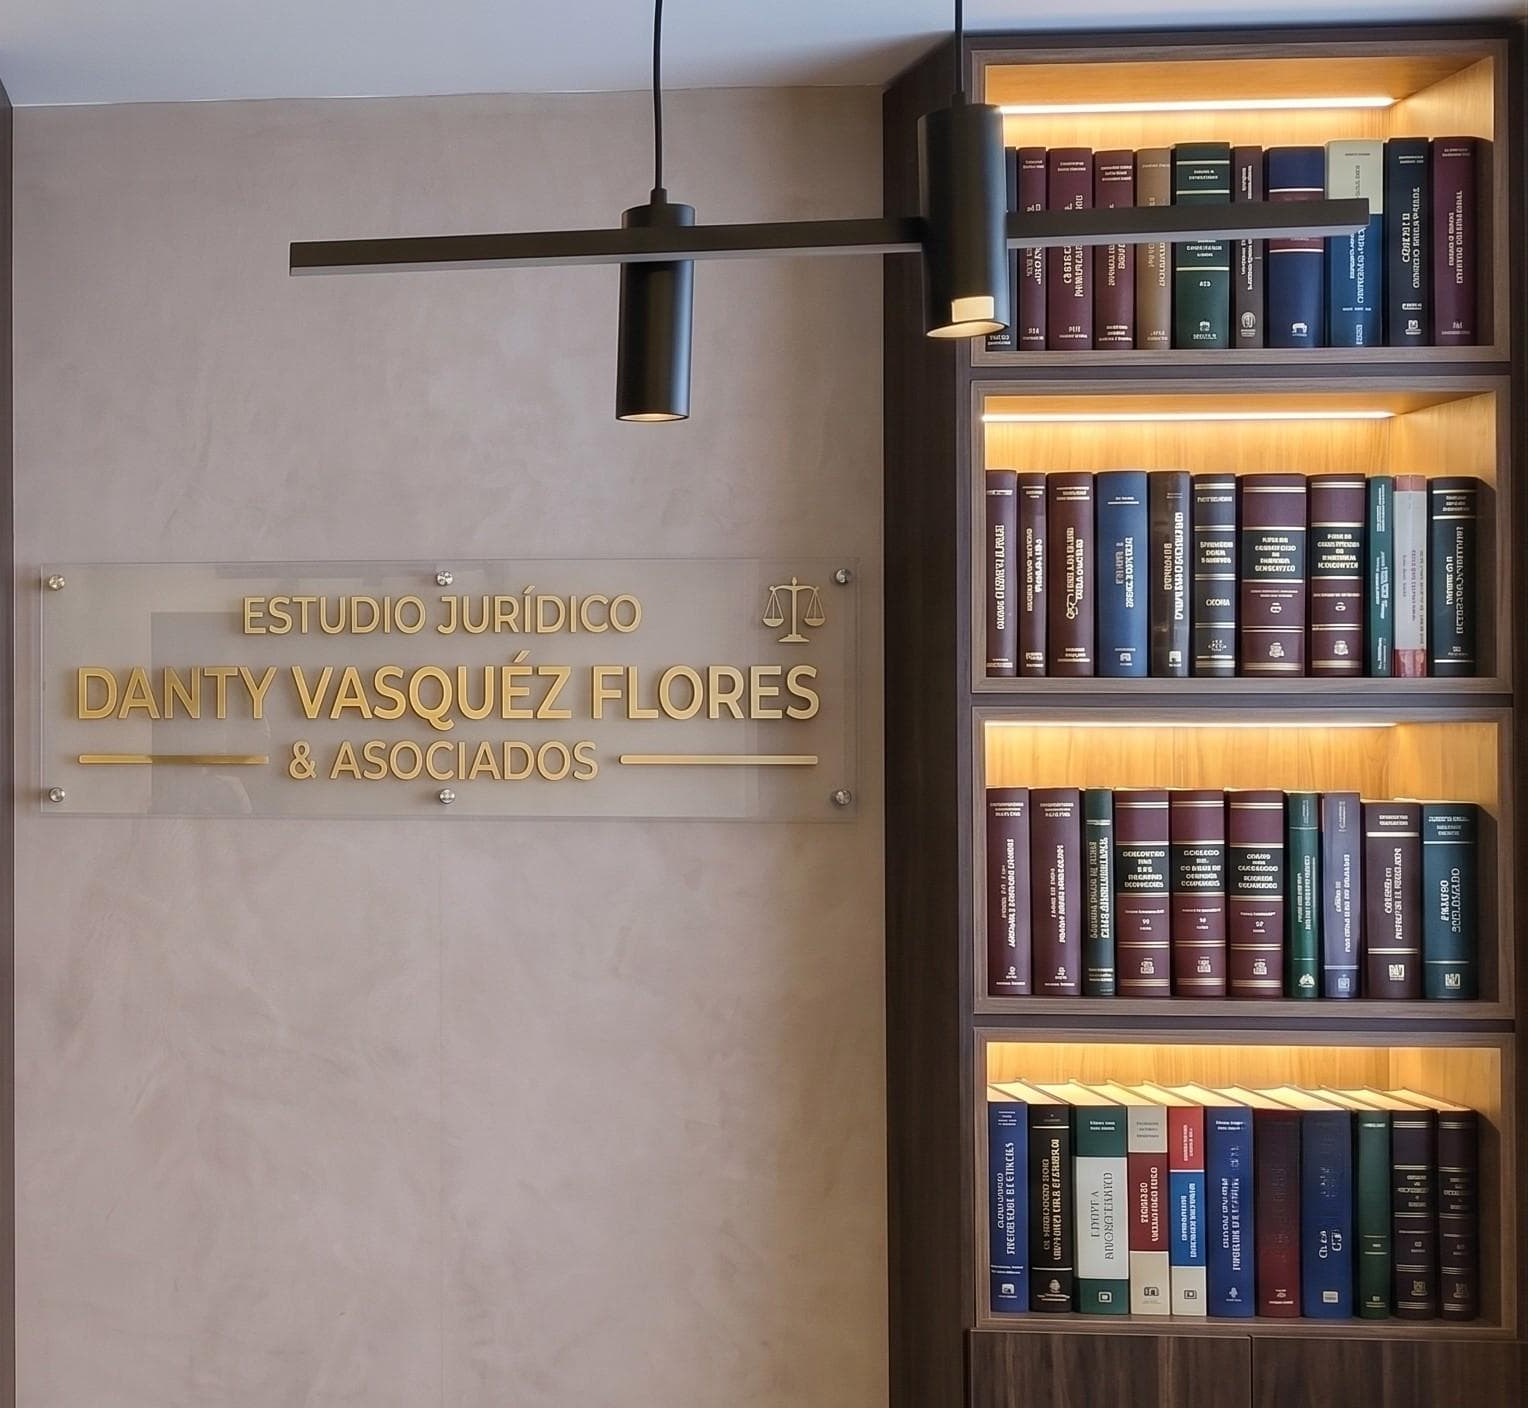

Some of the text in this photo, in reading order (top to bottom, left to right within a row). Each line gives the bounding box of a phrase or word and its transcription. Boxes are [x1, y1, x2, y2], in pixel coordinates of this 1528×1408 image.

[242, 584, 643, 635] ESTUDIO JURÍDICO
[78, 649, 821, 731] DANTY VASQUÉZ FLORES
[288, 739, 601, 781] & ASOCIADOS
